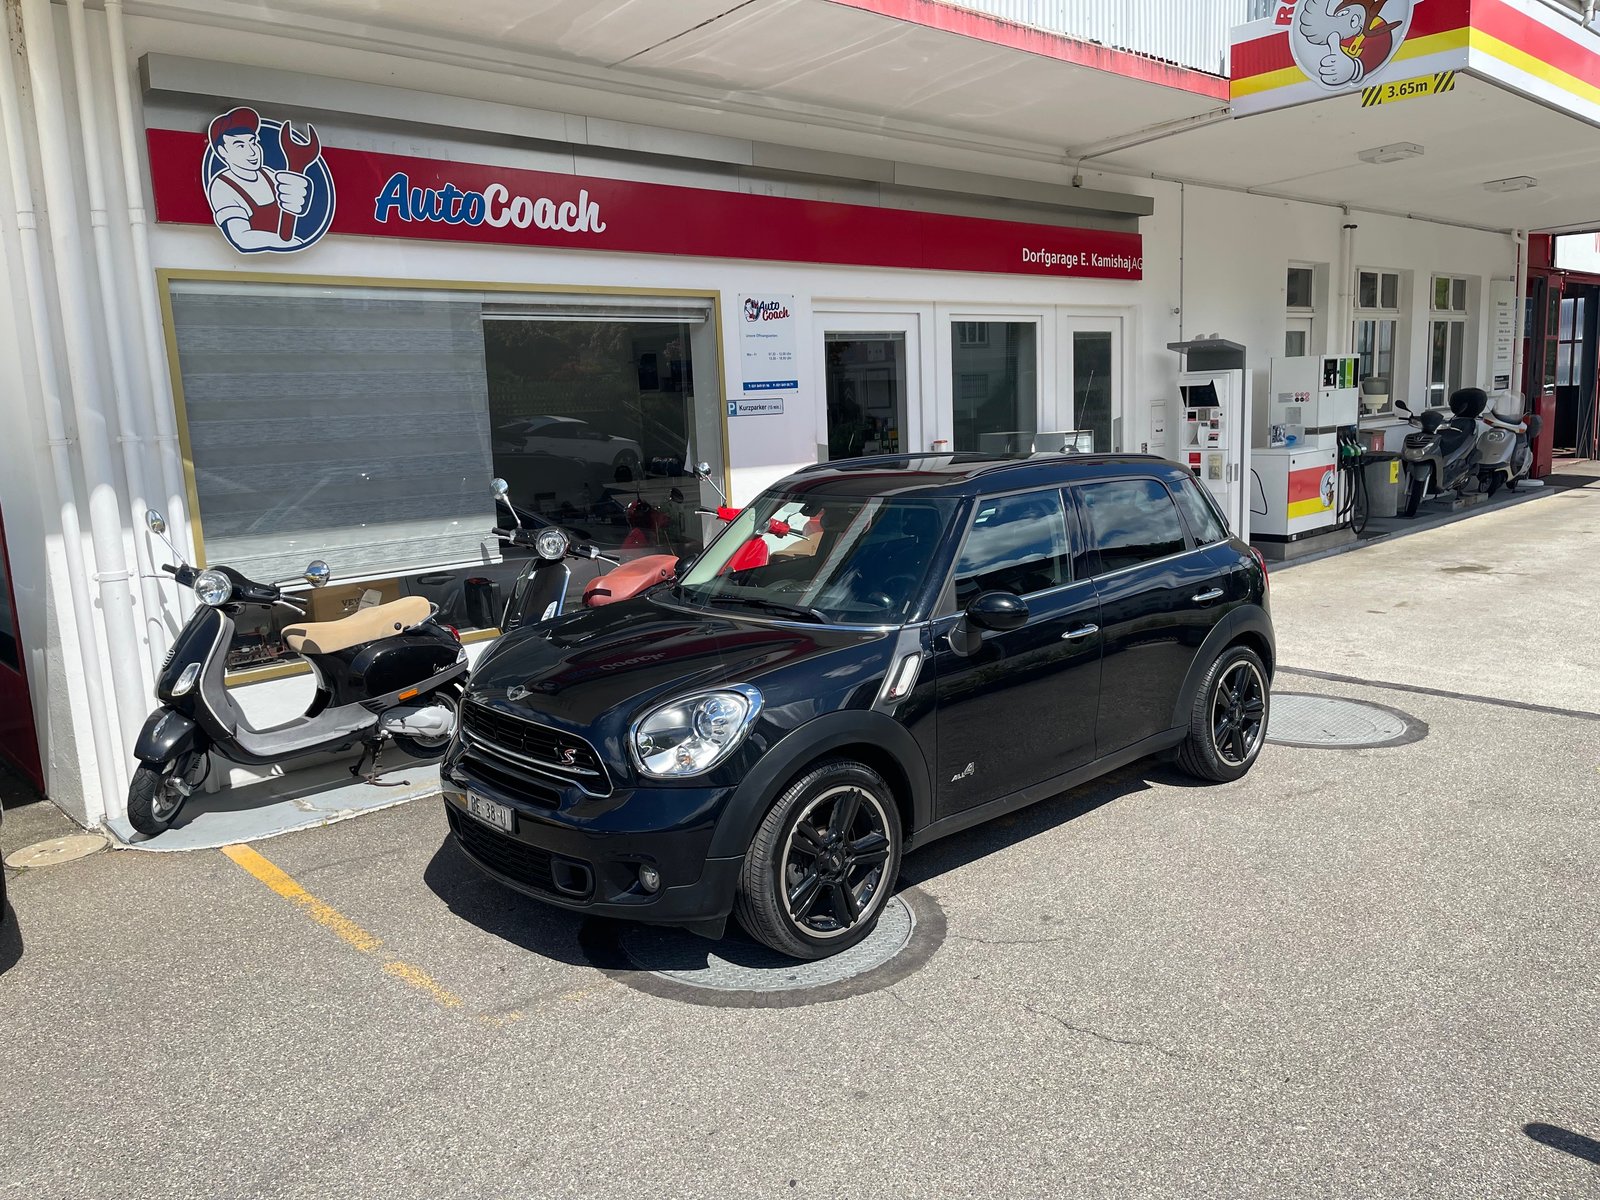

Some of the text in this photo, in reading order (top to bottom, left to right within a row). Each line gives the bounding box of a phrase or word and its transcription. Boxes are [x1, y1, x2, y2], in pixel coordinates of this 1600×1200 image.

[1275, 0, 1296, 26] R
[1387, 80, 1428, 98] 3.65m
[1022, 247, 1078, 268] Dorfgarage
[1080, 252, 1089, 266] E.
[759, 300, 780, 311] Auto
[762, 306, 790, 321] Coach
[728, 402, 735, 415] P
[341, 598, 361, 607] VEV
